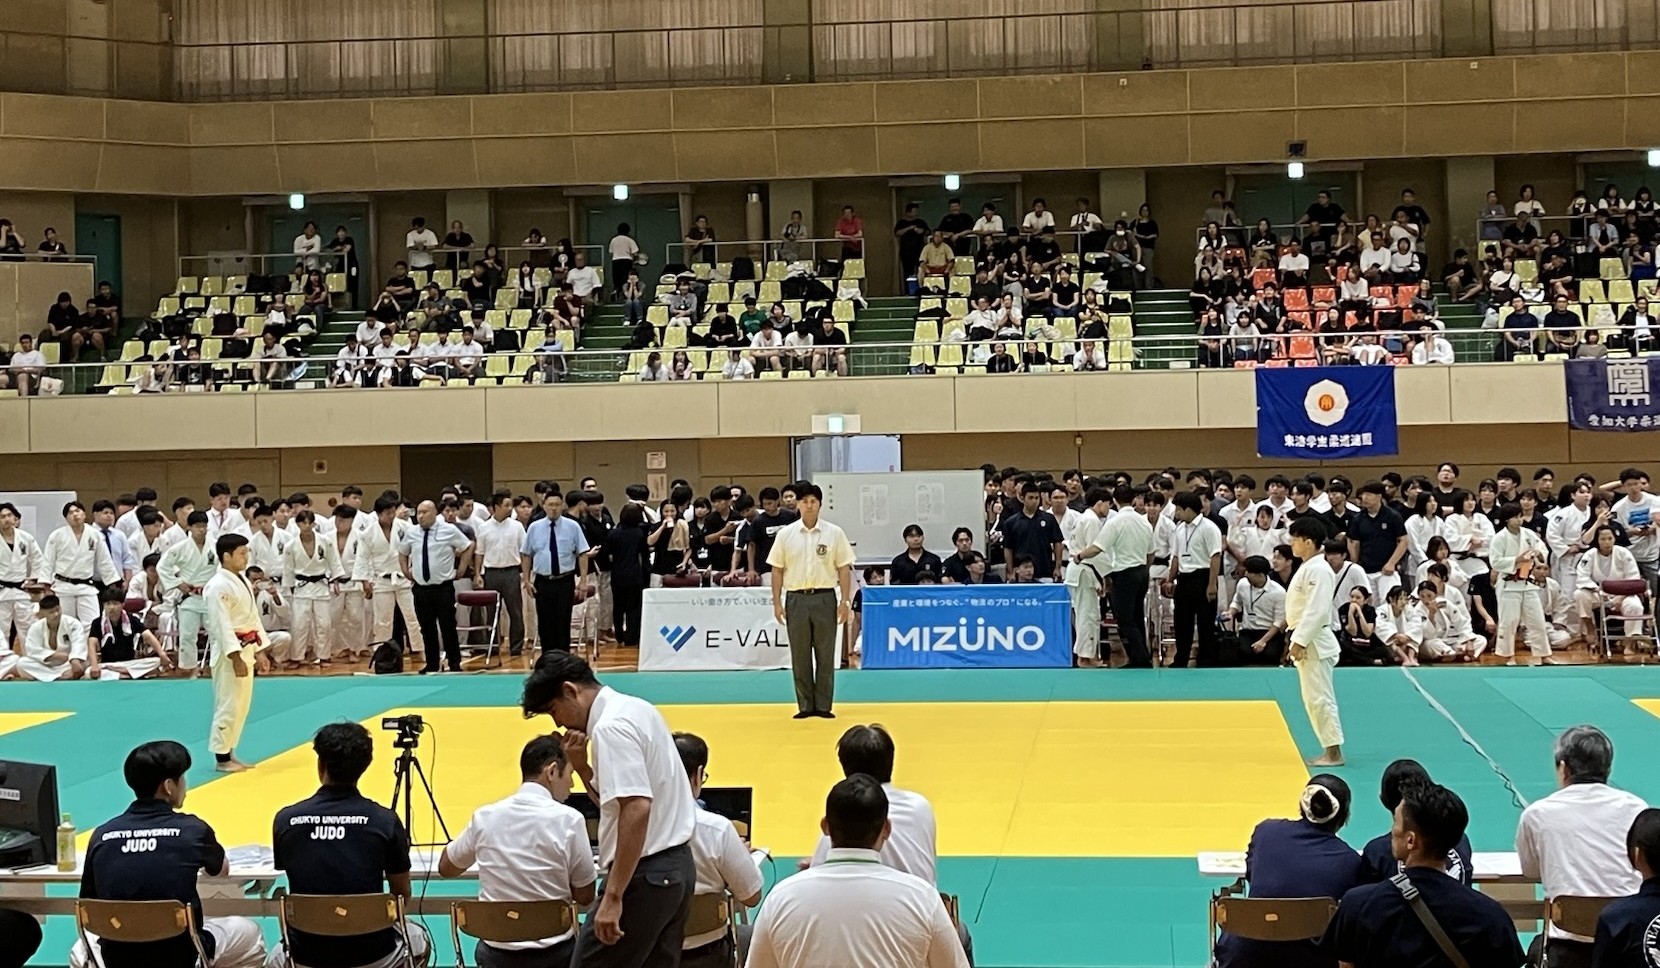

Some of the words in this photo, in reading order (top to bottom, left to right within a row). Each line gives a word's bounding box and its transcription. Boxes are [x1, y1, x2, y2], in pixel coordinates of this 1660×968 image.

[290, 815, 320, 826] CHUKYO
[322, 815, 369, 825] UNIVERSITY
[102, 830, 132, 841] CHUKYO
[133, 828, 181, 838] UNIVERSITY
[310, 826, 346, 840] JUDO
[121, 838, 157, 853] JUDO
